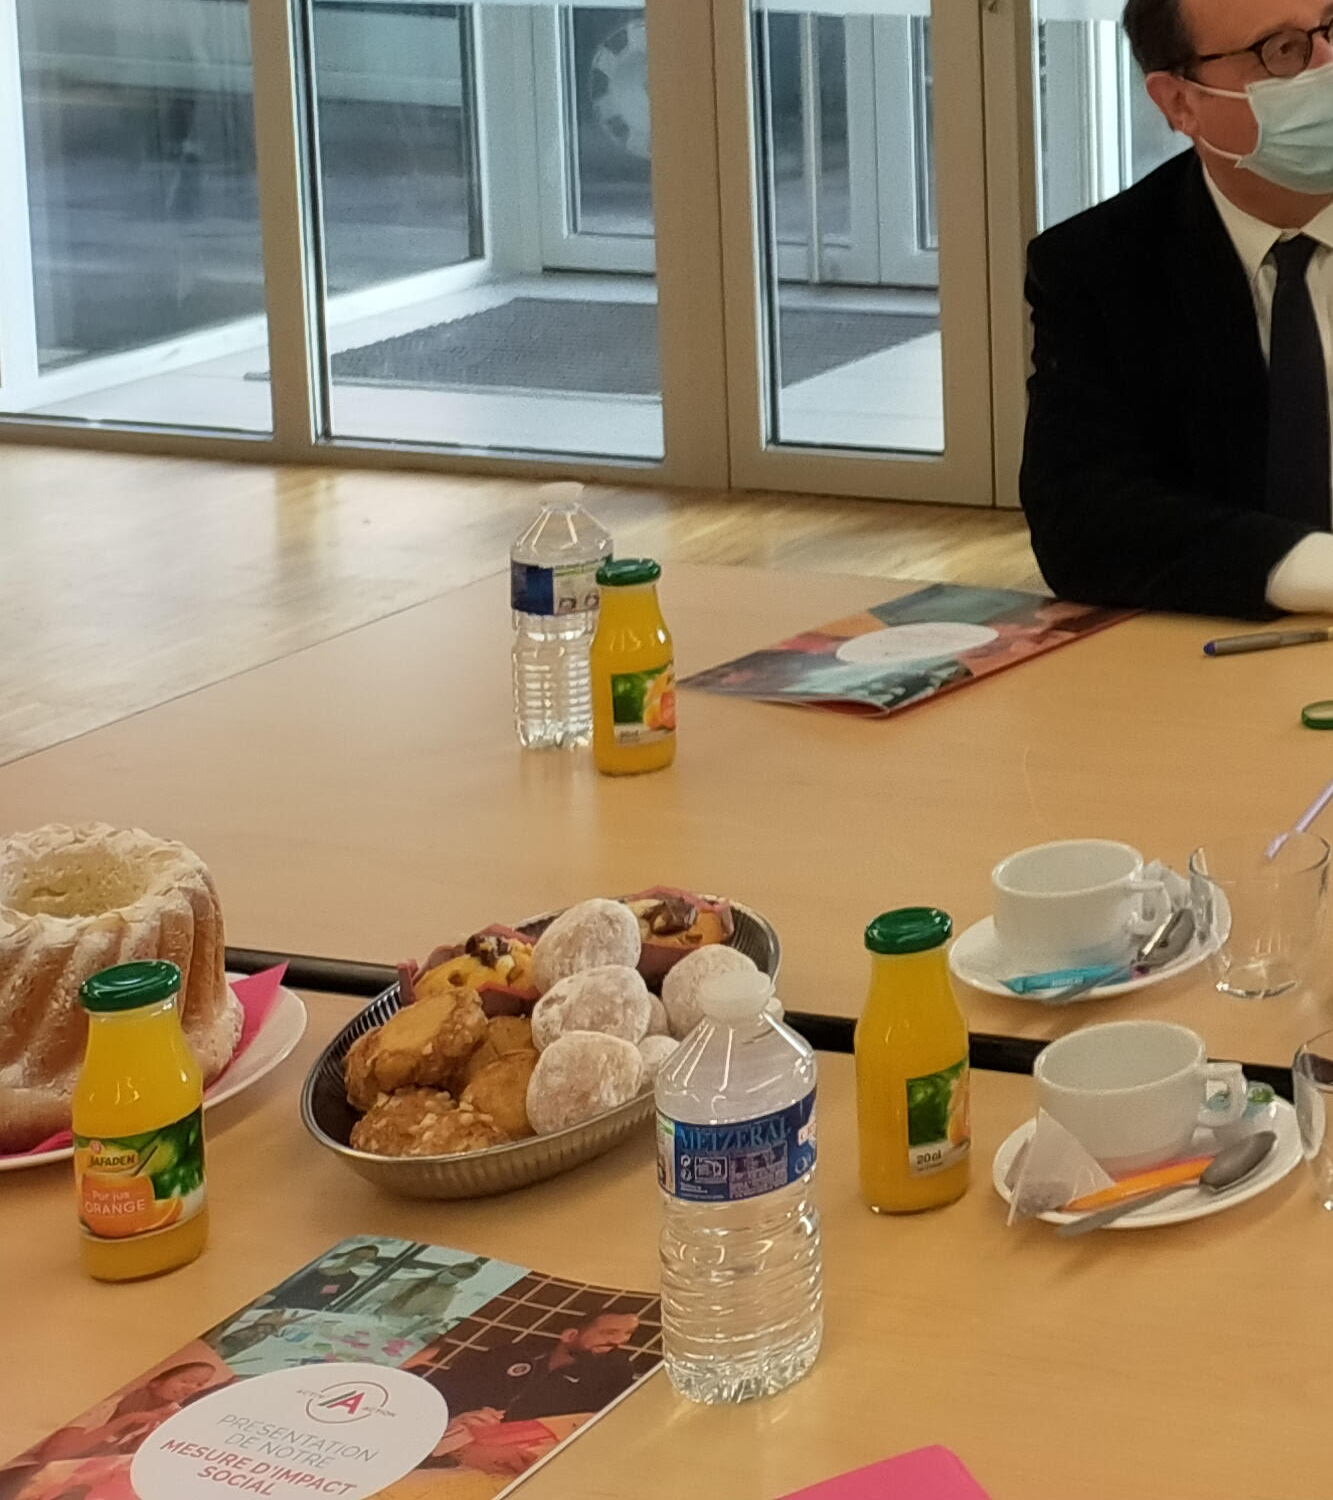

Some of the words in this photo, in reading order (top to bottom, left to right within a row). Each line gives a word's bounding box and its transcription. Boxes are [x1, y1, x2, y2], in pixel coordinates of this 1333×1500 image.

[85, 1199, 145, 1215] ORANGE
[224, 1432, 260, 1450] DE
[257, 1441, 336, 1469] NOTRE
[159, 1439, 250, 1471] MESURE
[249, 1461, 358, 1496] D'IMPACT
[197, 1466, 274, 1496] SOCIAL
